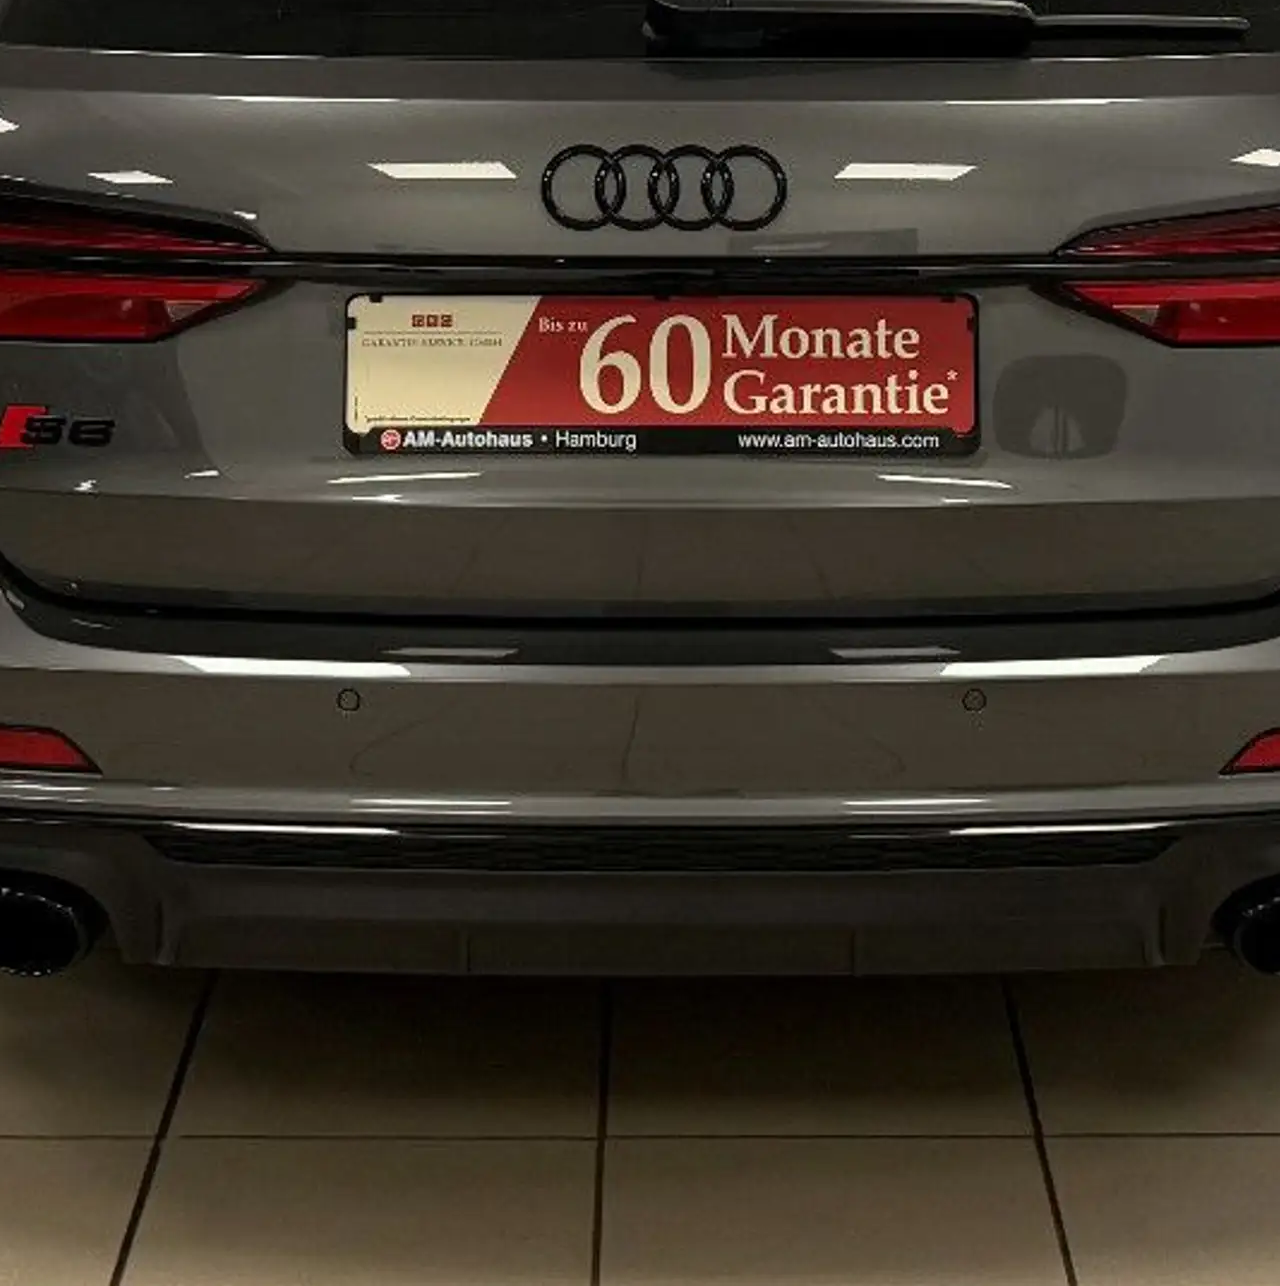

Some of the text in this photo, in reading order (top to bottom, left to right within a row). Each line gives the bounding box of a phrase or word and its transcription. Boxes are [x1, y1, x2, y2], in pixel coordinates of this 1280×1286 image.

[538, 316, 589, 333] Bis zu
[721, 313, 920, 360] Monate
[579, 313, 712, 415] 60
[12, 411, 116, 448] S6
[402, 429, 638, 452] AM-Autohaus Hamburg
[737, 431, 940, 449] www.am-autohaus.com
